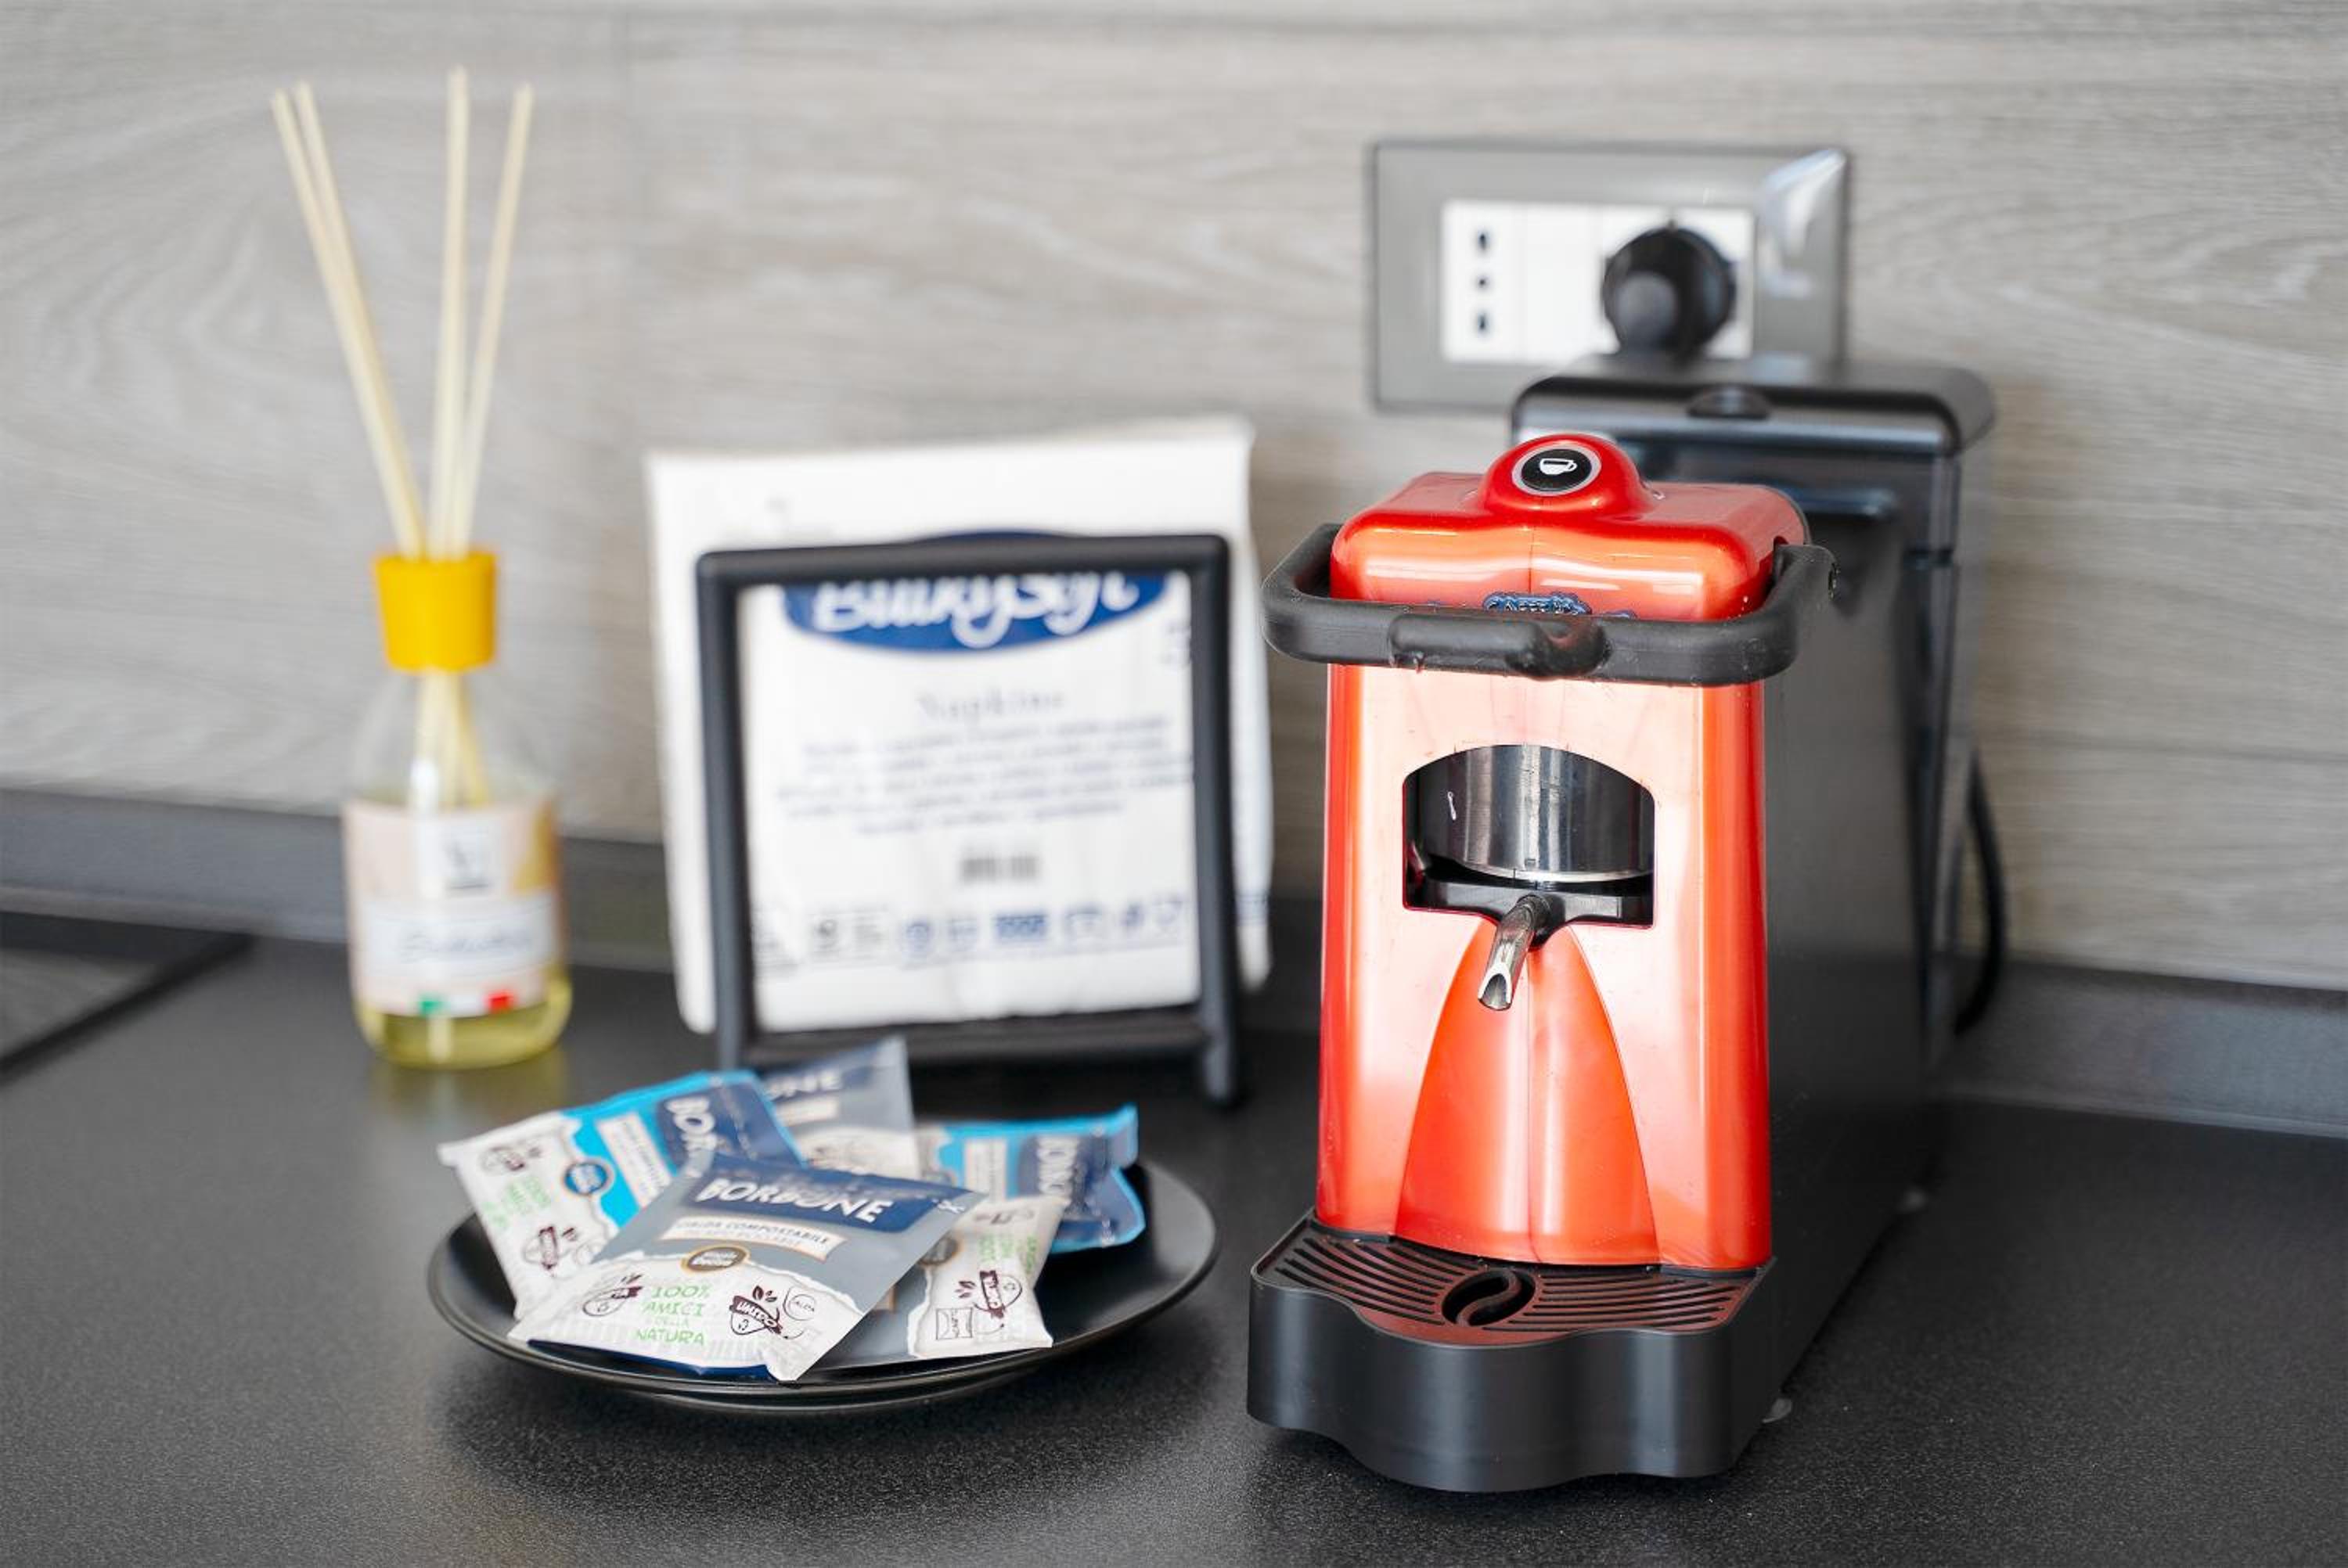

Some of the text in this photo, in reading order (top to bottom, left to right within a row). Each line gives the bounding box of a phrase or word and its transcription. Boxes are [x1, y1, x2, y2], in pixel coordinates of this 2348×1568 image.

[696, 1178, 893, 1223] BORBONE
[651, 1282, 713, 1300] 100%
[641, 1302, 704, 1317] AMICI
[636, 1329, 705, 1346] NATURA
